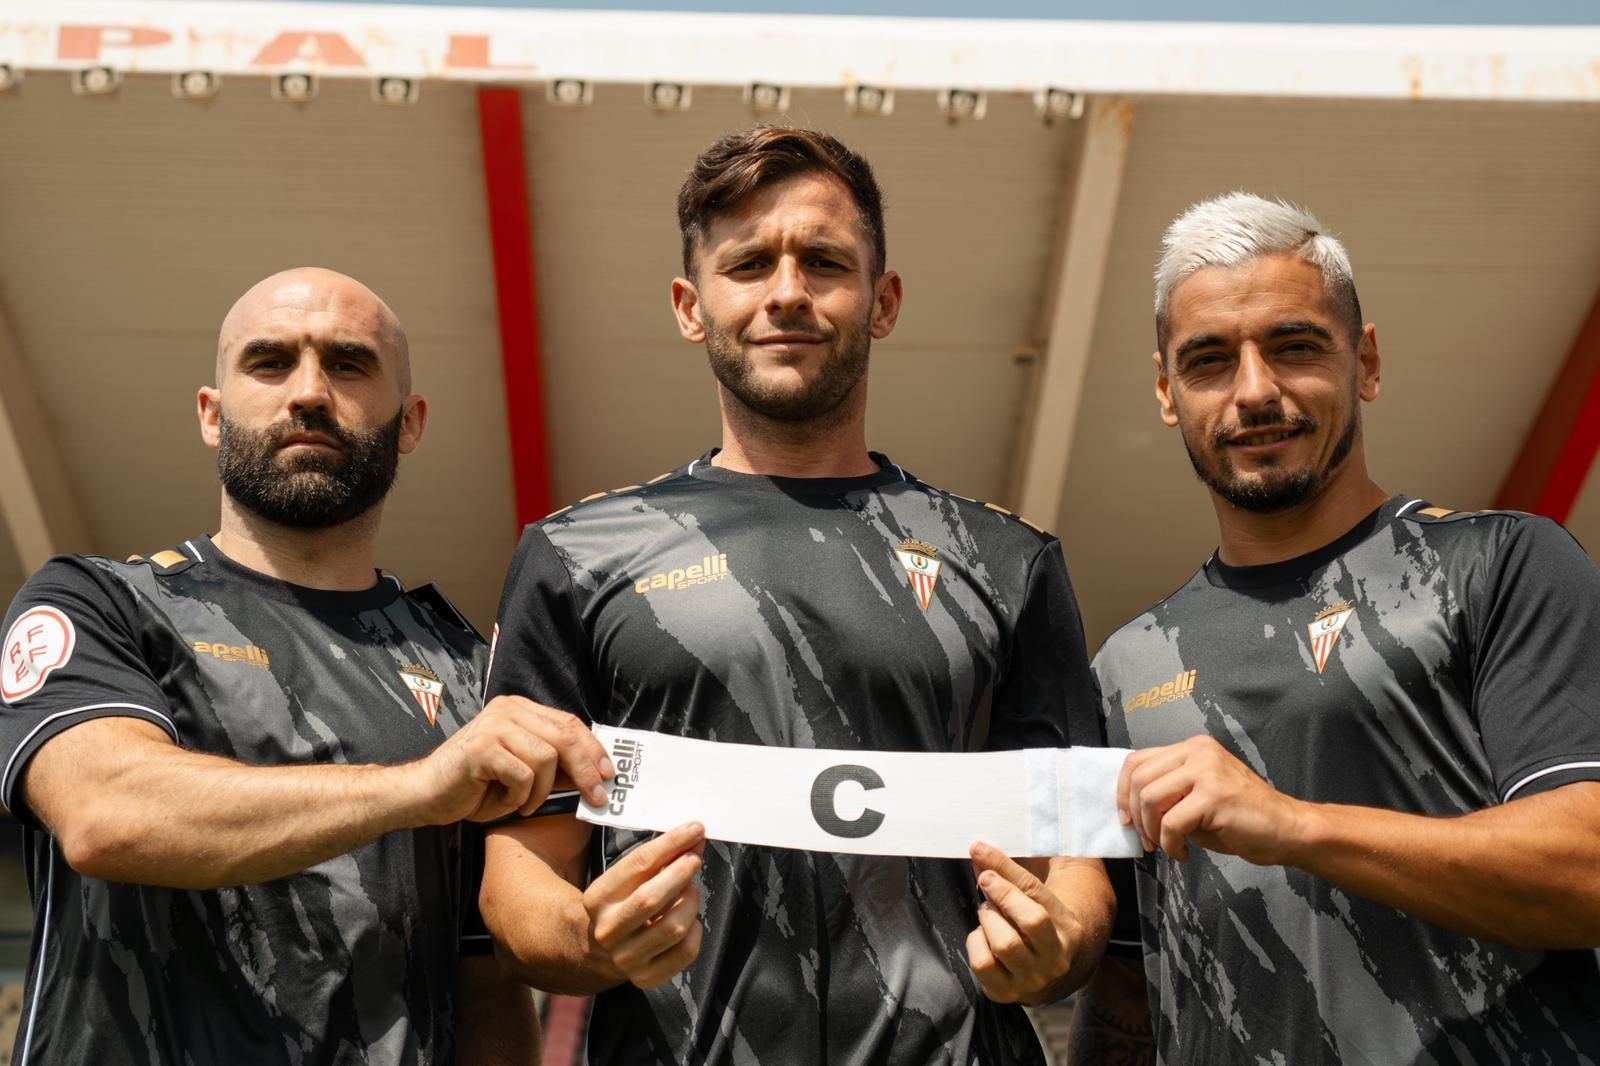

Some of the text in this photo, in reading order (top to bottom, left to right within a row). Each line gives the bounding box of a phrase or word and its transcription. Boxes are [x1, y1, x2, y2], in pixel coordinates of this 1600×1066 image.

[635, 553, 727, 593] capelli
[677, 573, 727, 590] SPORT
[185, 640, 270, 665] apelli
[1123, 669, 1197, 714] capelli
[609, 738, 636, 816] capelli
[631, 741, 644, 782] SPORT
[810, 764, 886, 839] C
